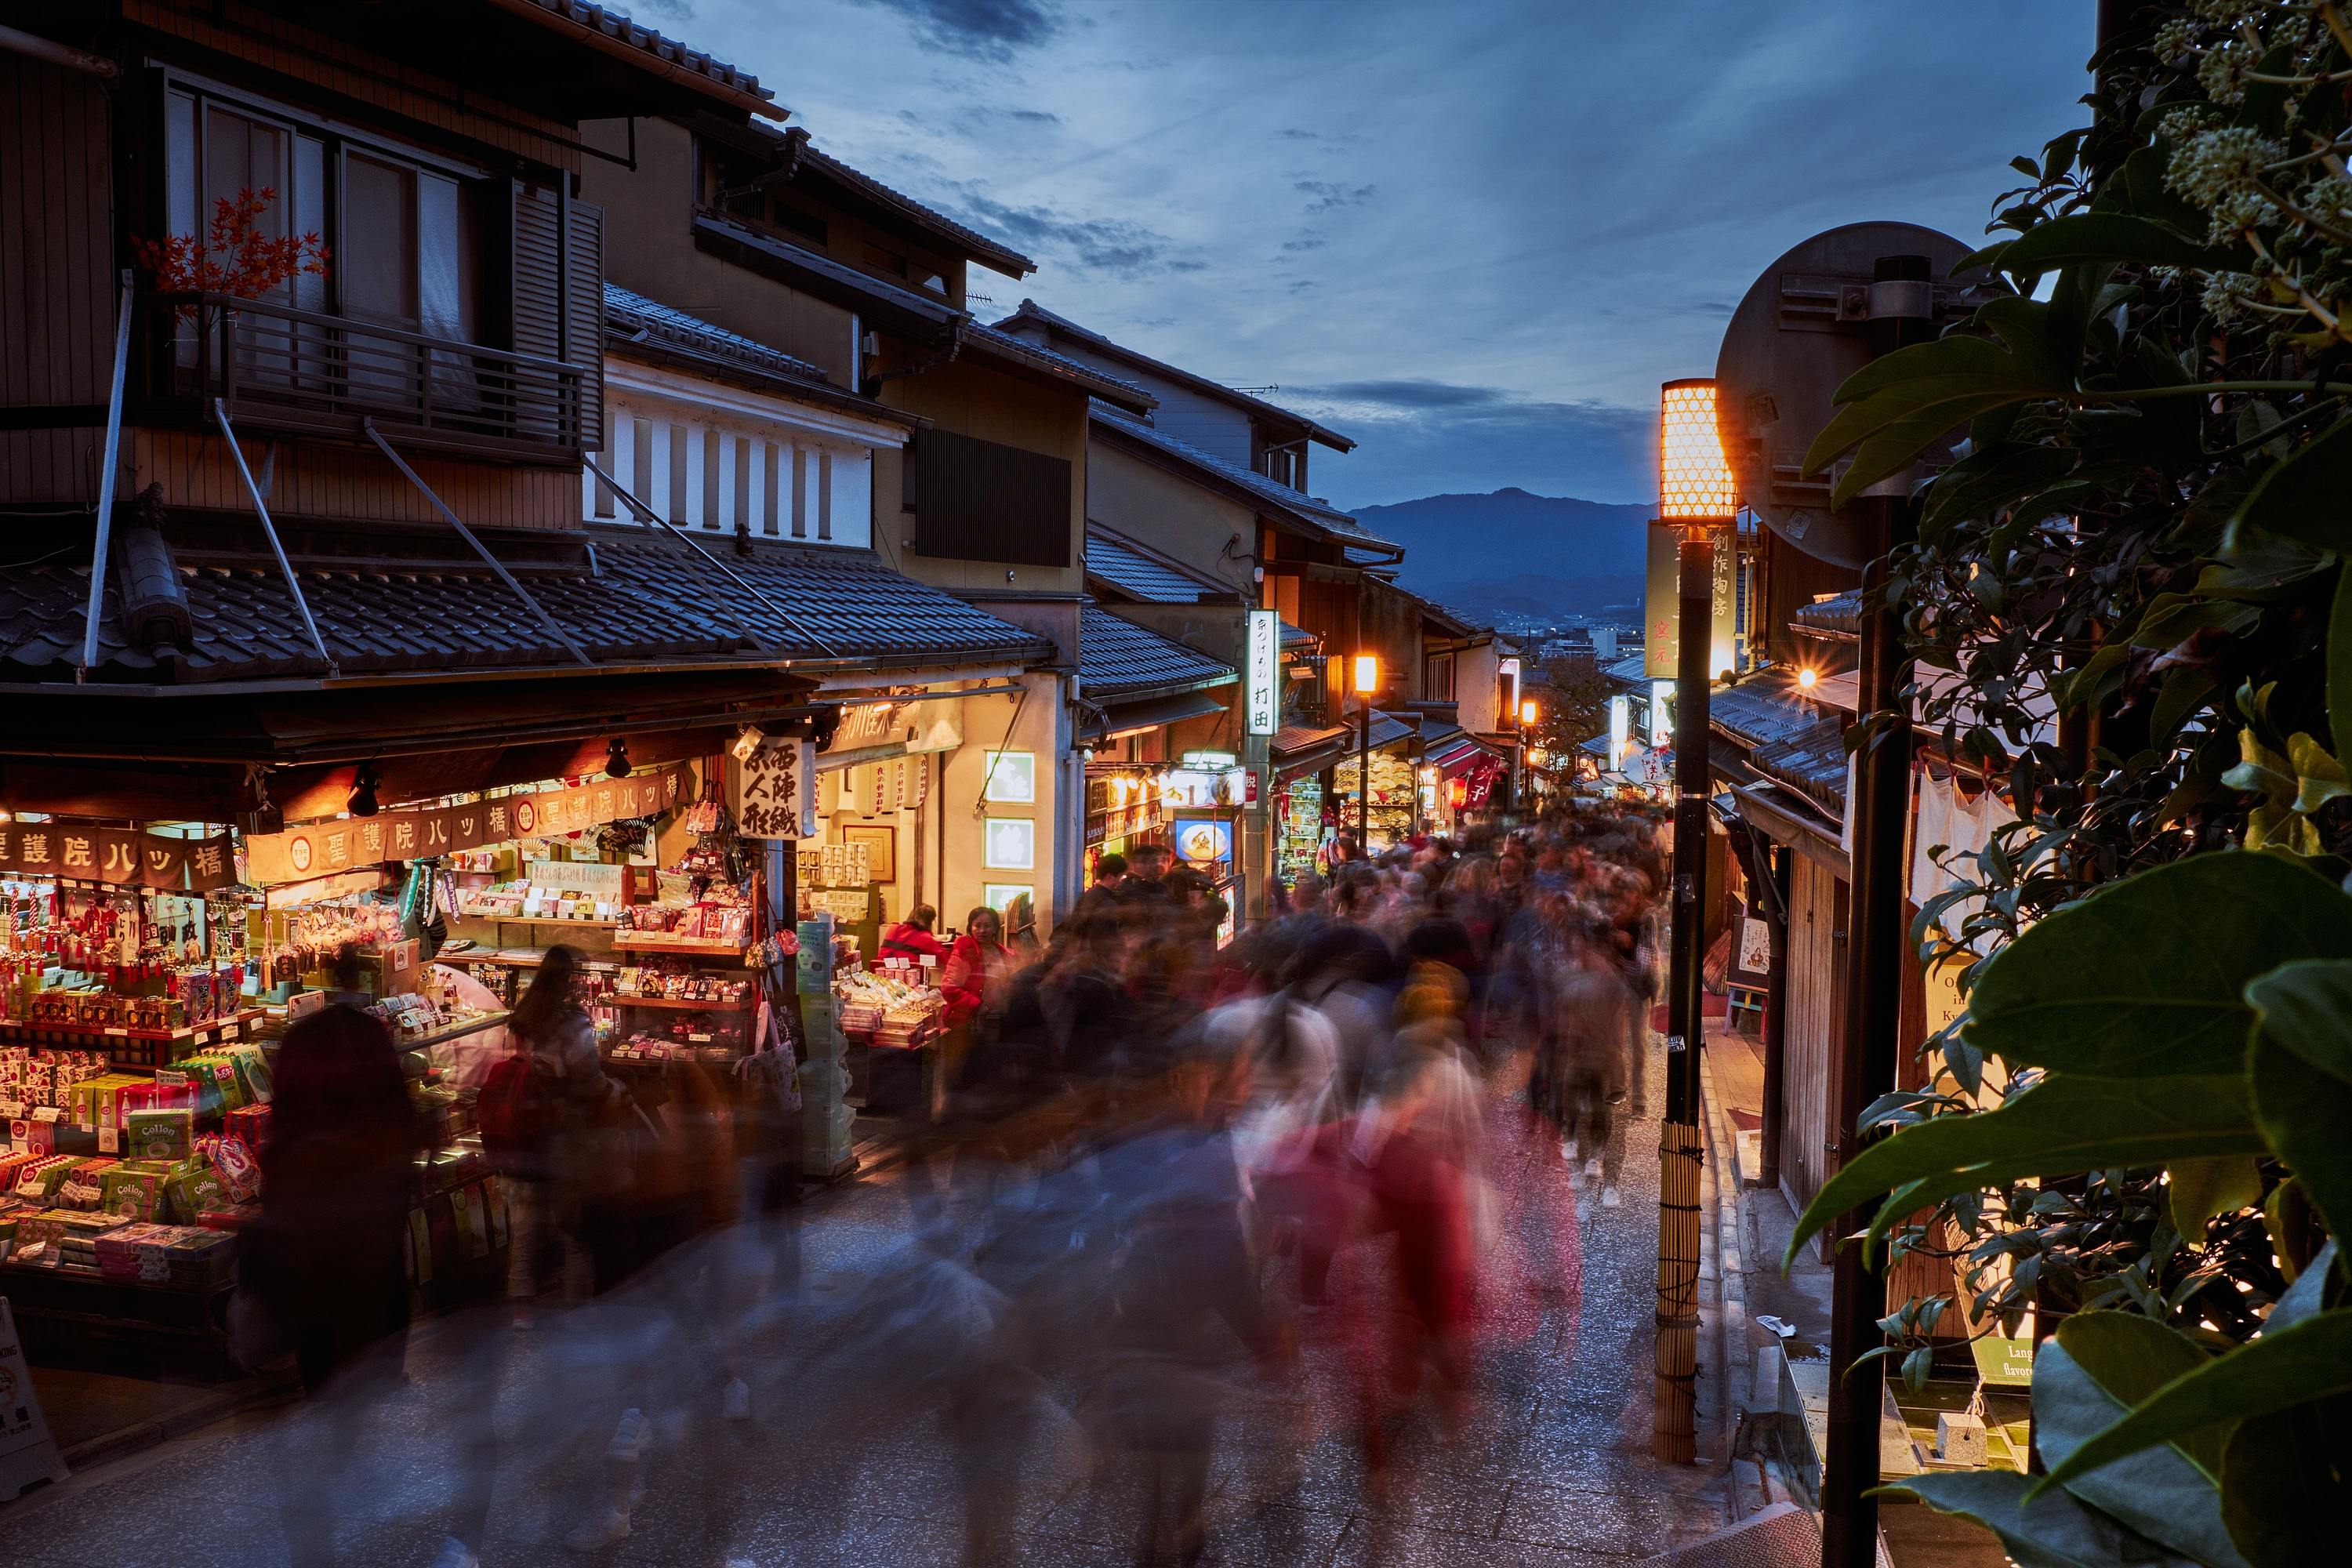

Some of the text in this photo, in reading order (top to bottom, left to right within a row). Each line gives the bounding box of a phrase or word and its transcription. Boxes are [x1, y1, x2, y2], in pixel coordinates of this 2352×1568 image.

[1254, 687, 1269, 728] 打田
[546, 774, 678, 825] 聖護院八ツ橋
[328, 806, 506, 864] 聖護院八ツ橋
[141, 1123, 176, 1137] Collon
[118, 1184, 143, 1198] Collon
[194, 1180, 218, 1196] Collon
